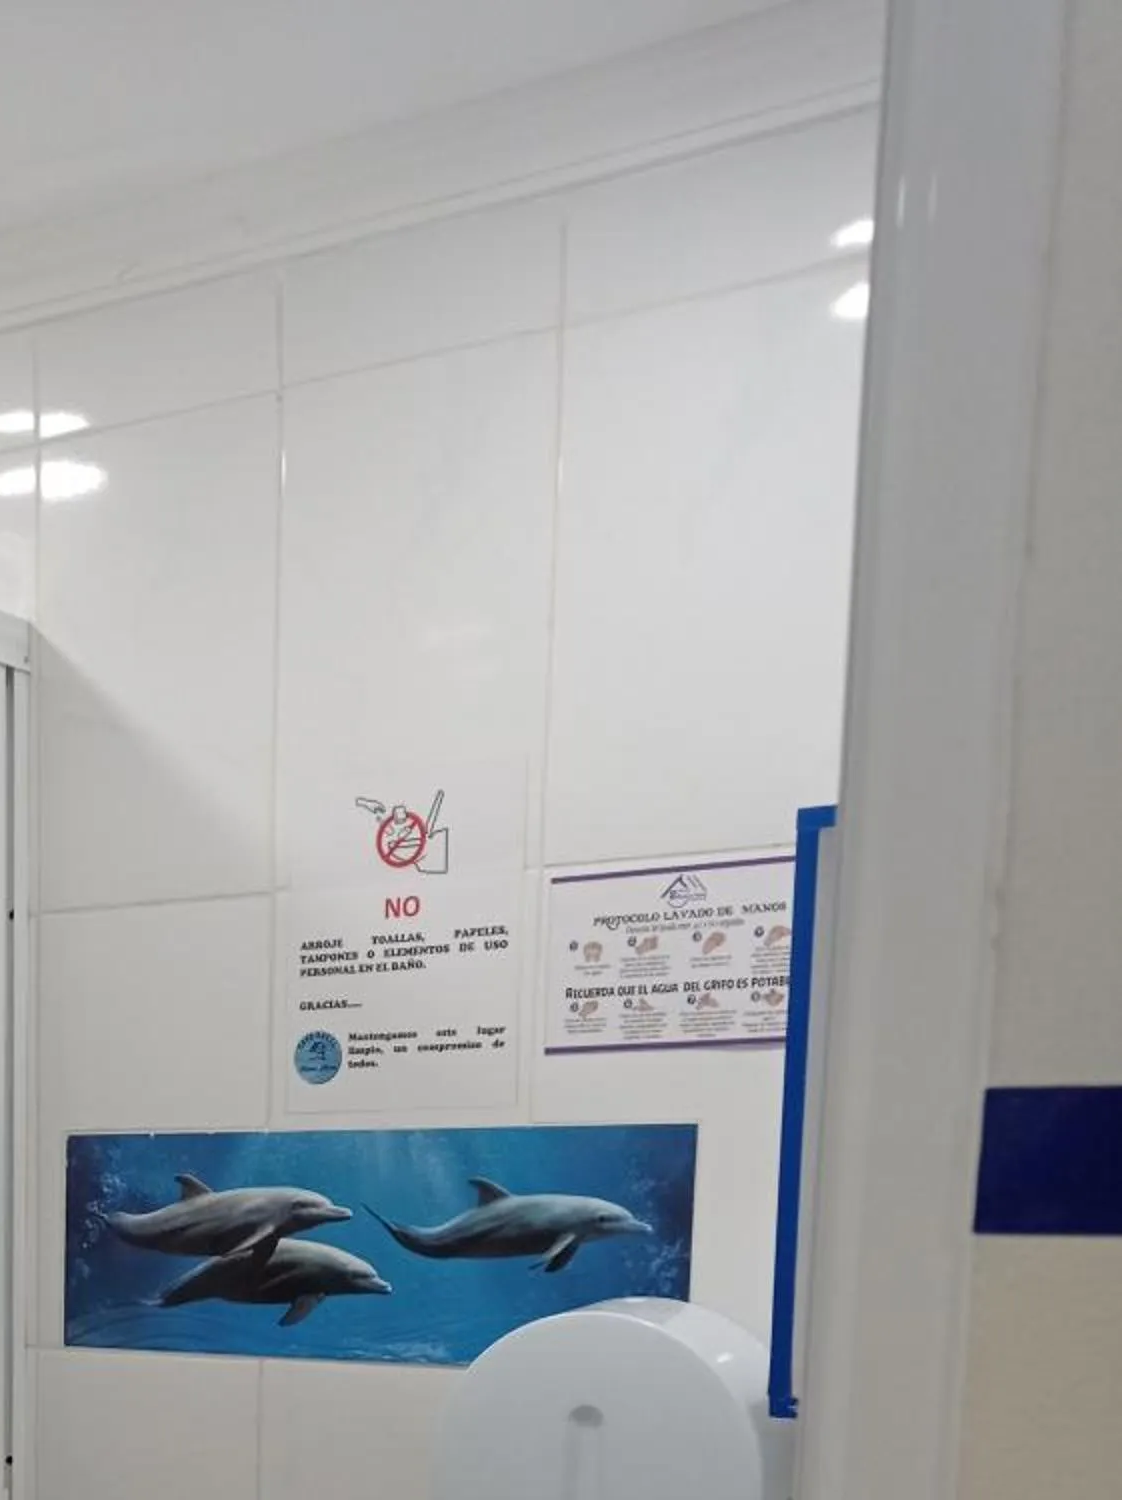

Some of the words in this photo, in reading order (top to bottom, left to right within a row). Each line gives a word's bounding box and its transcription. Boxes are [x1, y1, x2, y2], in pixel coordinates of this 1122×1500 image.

[384, 895, 420, 918] NO
[593, 912, 660, 931] PROTOCOLO
[664, 908, 713, 921] LAVADO
[717, 906, 733, 916] DE
[299, 951, 358, 964] TAMPONES
[366, 949, 375, 959] O
[383, 943, 450, 958] ELEMENTOS
[459, 941, 474, 953] DE
[484, 939, 509, 951] USO
[299, 964, 357, 977] PERSONAL
[358, 963, 374, 973] EN
[376, 962, 390, 972] EL
[566, 987, 615, 999] RECUERDA
[617, 985, 635, 996] QUE
[638, 984, 648, 995] EL
[651, 982, 678, 994] AGUA
[683, 981, 701, 993] DEL
[736, 977, 749, 989] ES
[477, 1025, 506, 1037] lugar
